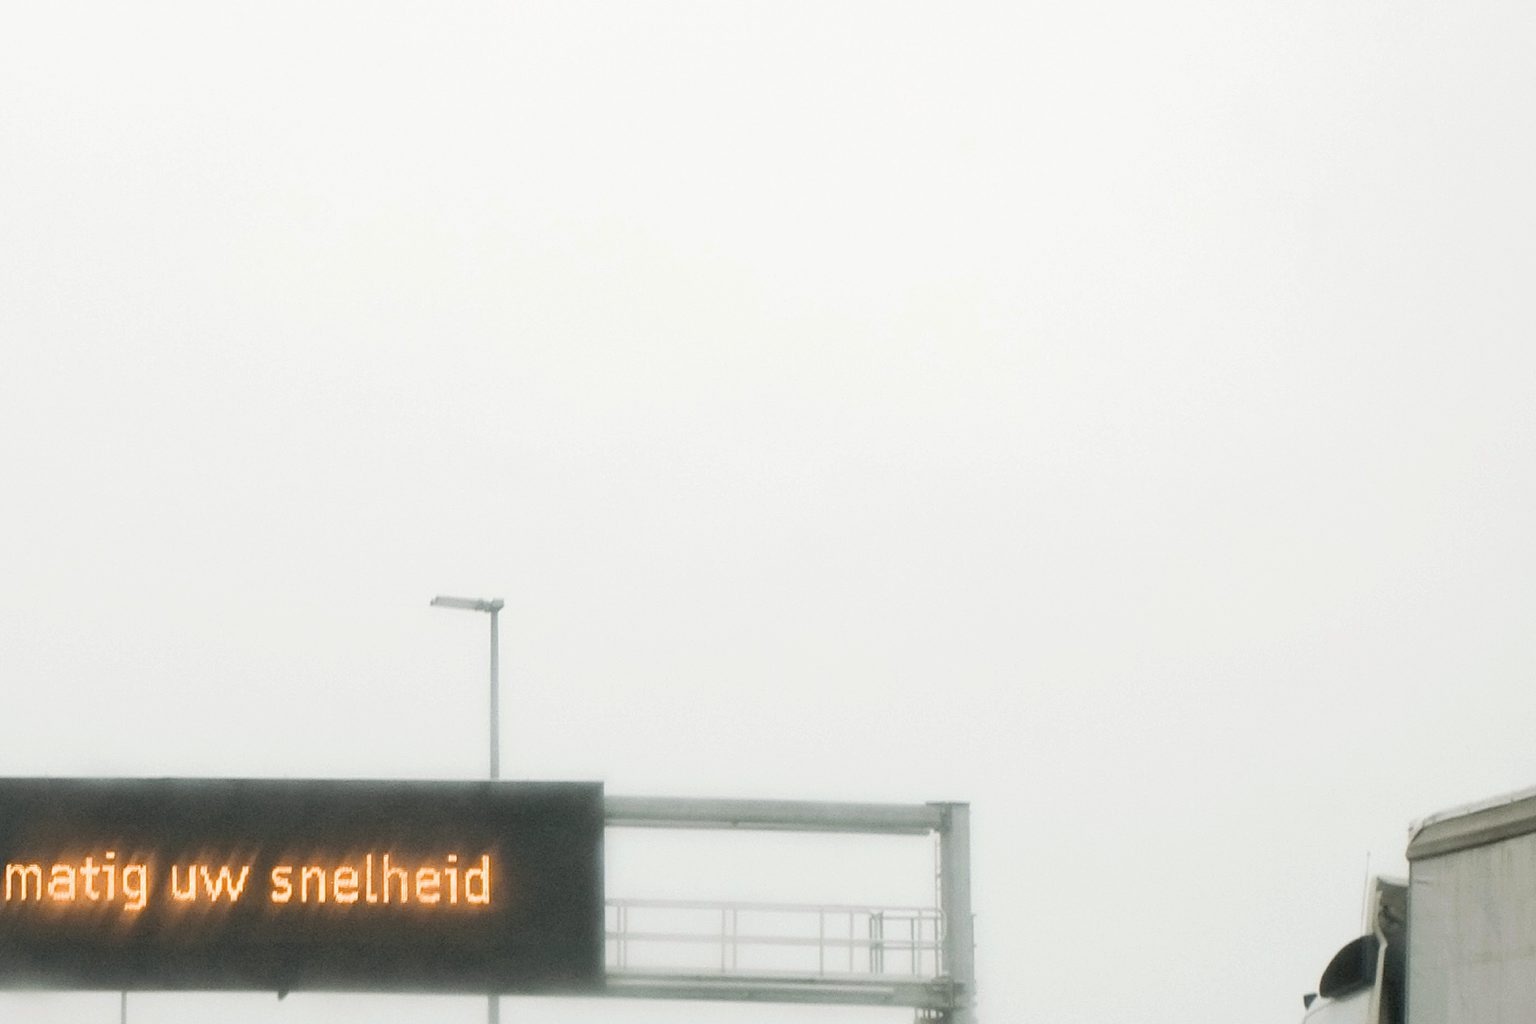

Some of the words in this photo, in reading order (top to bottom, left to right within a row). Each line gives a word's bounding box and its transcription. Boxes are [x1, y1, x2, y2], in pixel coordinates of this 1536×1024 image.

[4, 851, 148, 912] matig
[170, 864, 250, 903] uw
[271, 852, 491, 904] snelheid
